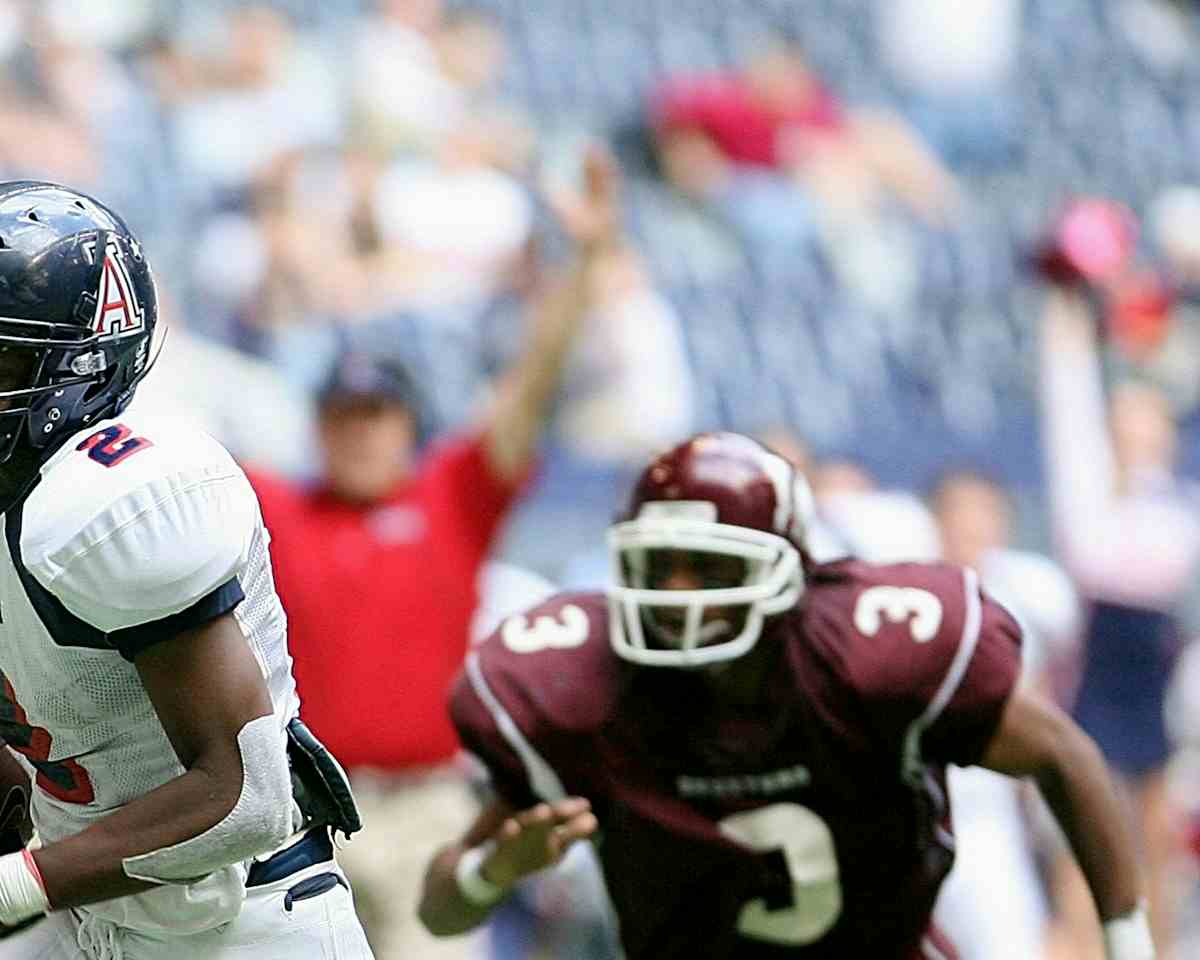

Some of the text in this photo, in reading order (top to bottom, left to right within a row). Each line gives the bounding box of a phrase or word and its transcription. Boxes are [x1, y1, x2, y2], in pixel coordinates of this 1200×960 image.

[82, 232, 145, 342] A
[75, 423, 154, 468] 2
[503, 603, 590, 654] 3
[853, 585, 943, 643] 3
[718, 801, 842, 946] 3
